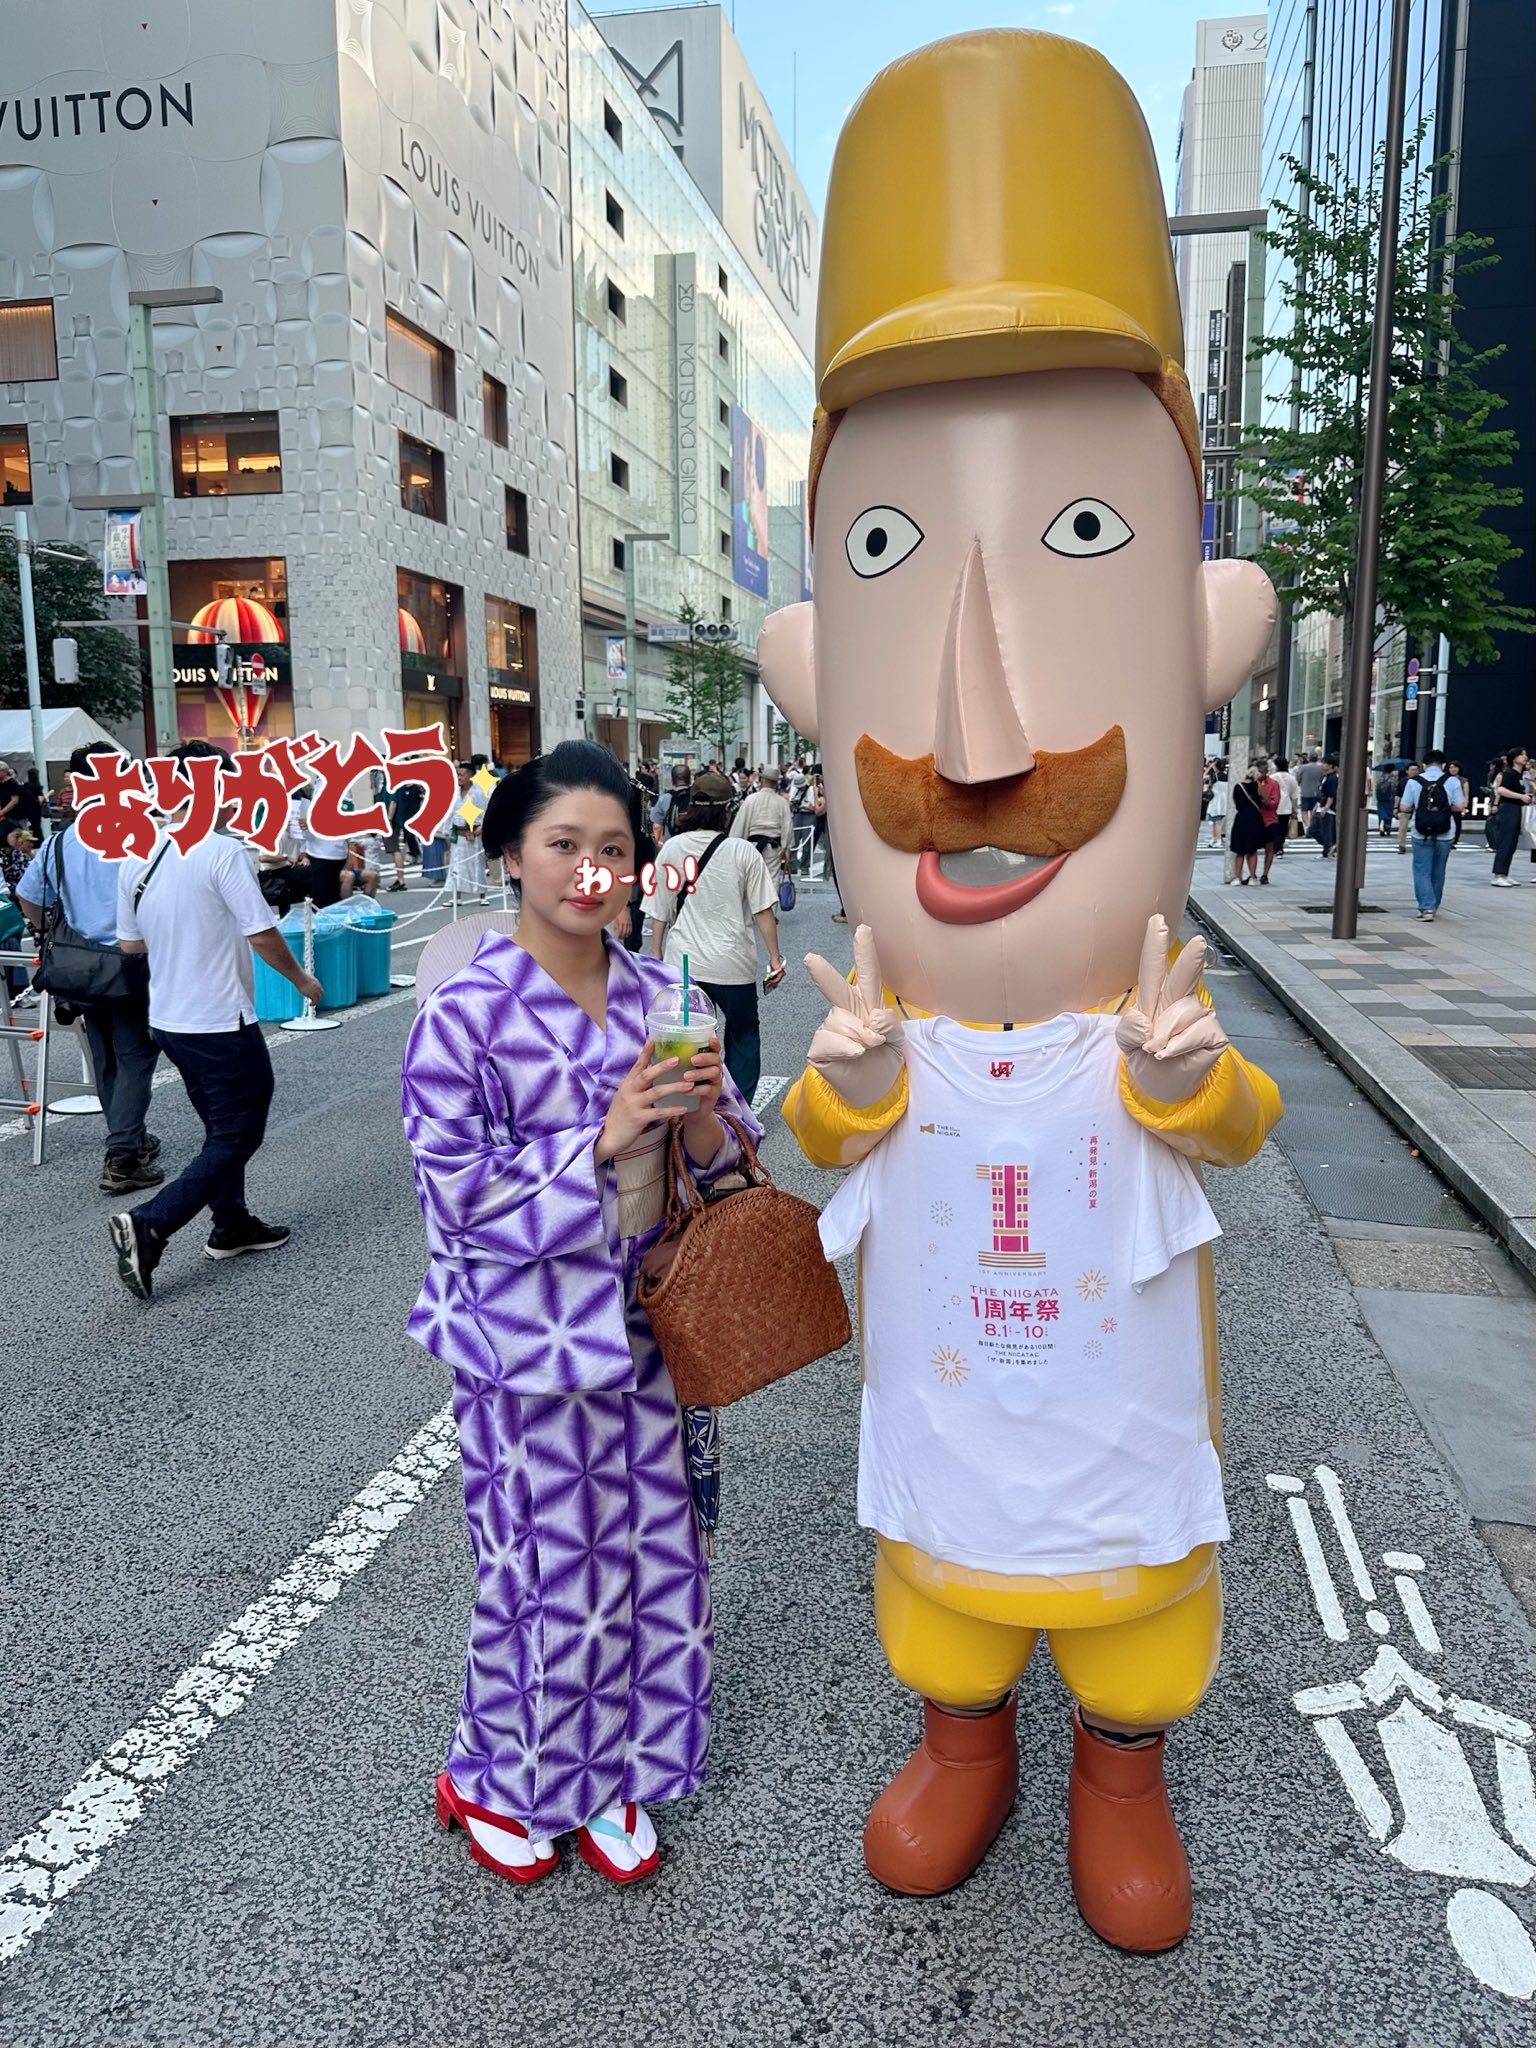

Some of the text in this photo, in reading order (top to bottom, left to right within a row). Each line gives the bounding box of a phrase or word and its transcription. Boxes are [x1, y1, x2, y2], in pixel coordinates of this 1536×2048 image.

[0, 82, 194, 141] UITTON
[400, 127, 540, 290] LOUIS VUITTON
[172, 667, 207, 683] OUIS
[936, 1130, 961, 1138] NIIGATA
[970, 1284, 1059, 1299] THE NIIGATA
[970, 1296, 1060, 1322] 1周年祭
